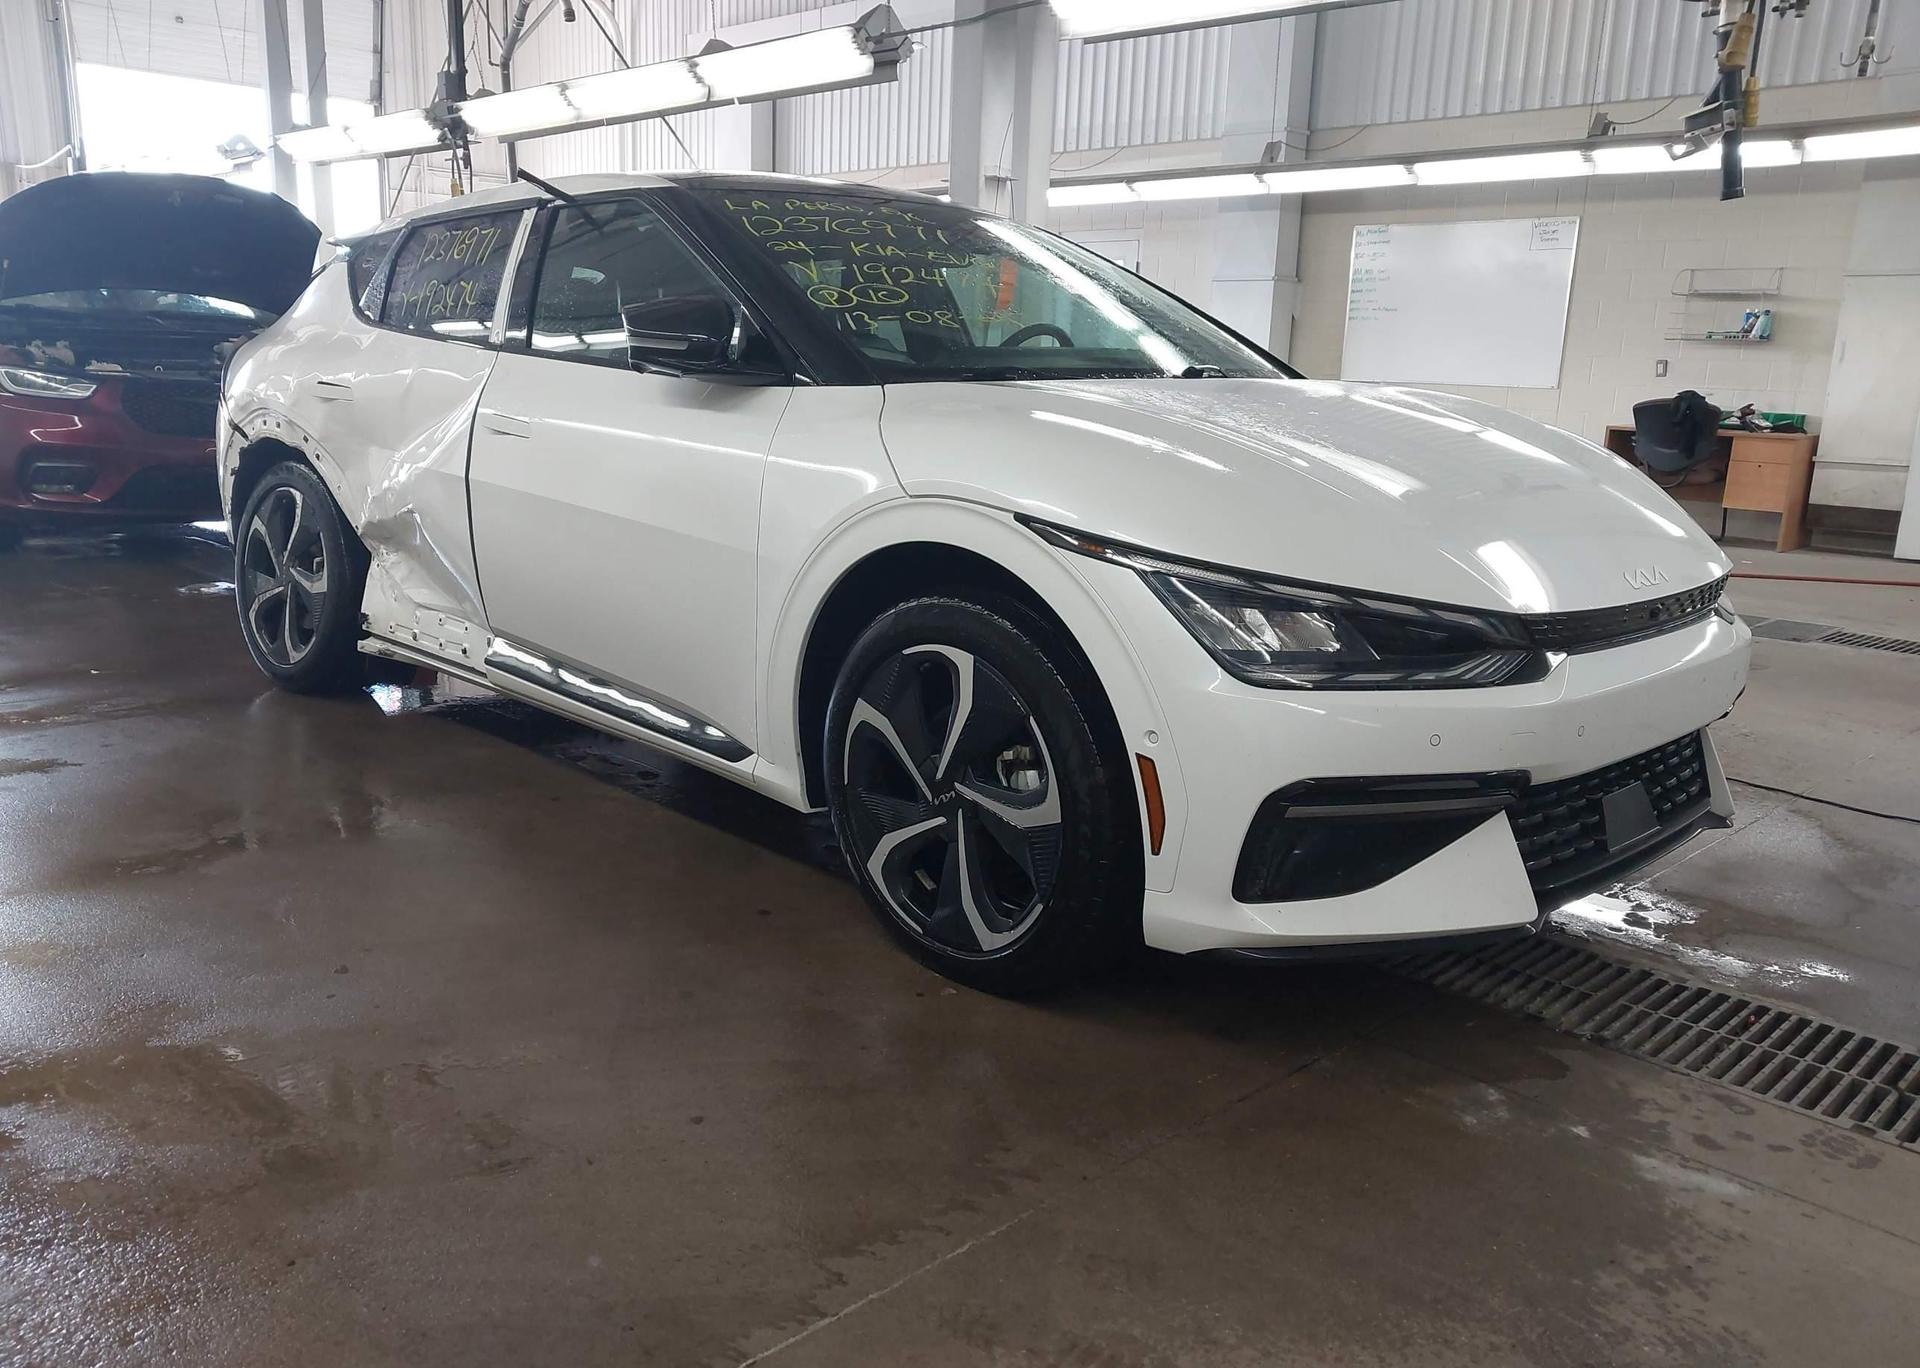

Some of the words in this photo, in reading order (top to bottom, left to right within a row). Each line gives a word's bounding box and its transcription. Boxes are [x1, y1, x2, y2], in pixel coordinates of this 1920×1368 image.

[725, 199, 770, 211] LA
[742, 214, 949, 246] 12376971
[416, 225, 502, 270] 12376971
